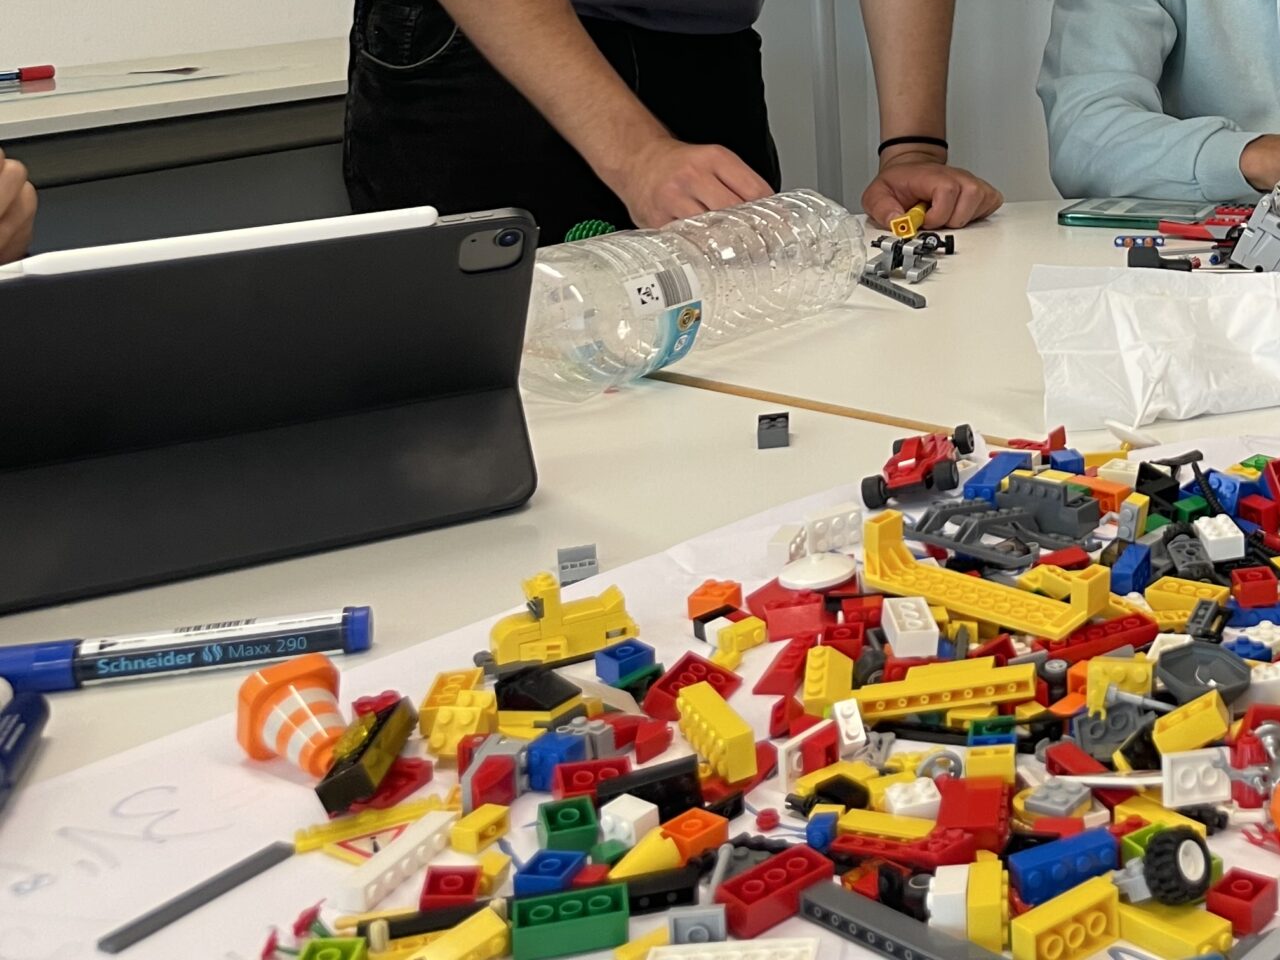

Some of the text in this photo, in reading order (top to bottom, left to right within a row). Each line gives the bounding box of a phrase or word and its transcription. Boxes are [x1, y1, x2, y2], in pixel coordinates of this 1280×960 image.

[97, 636, 307, 675] Schneider Maxx 290
